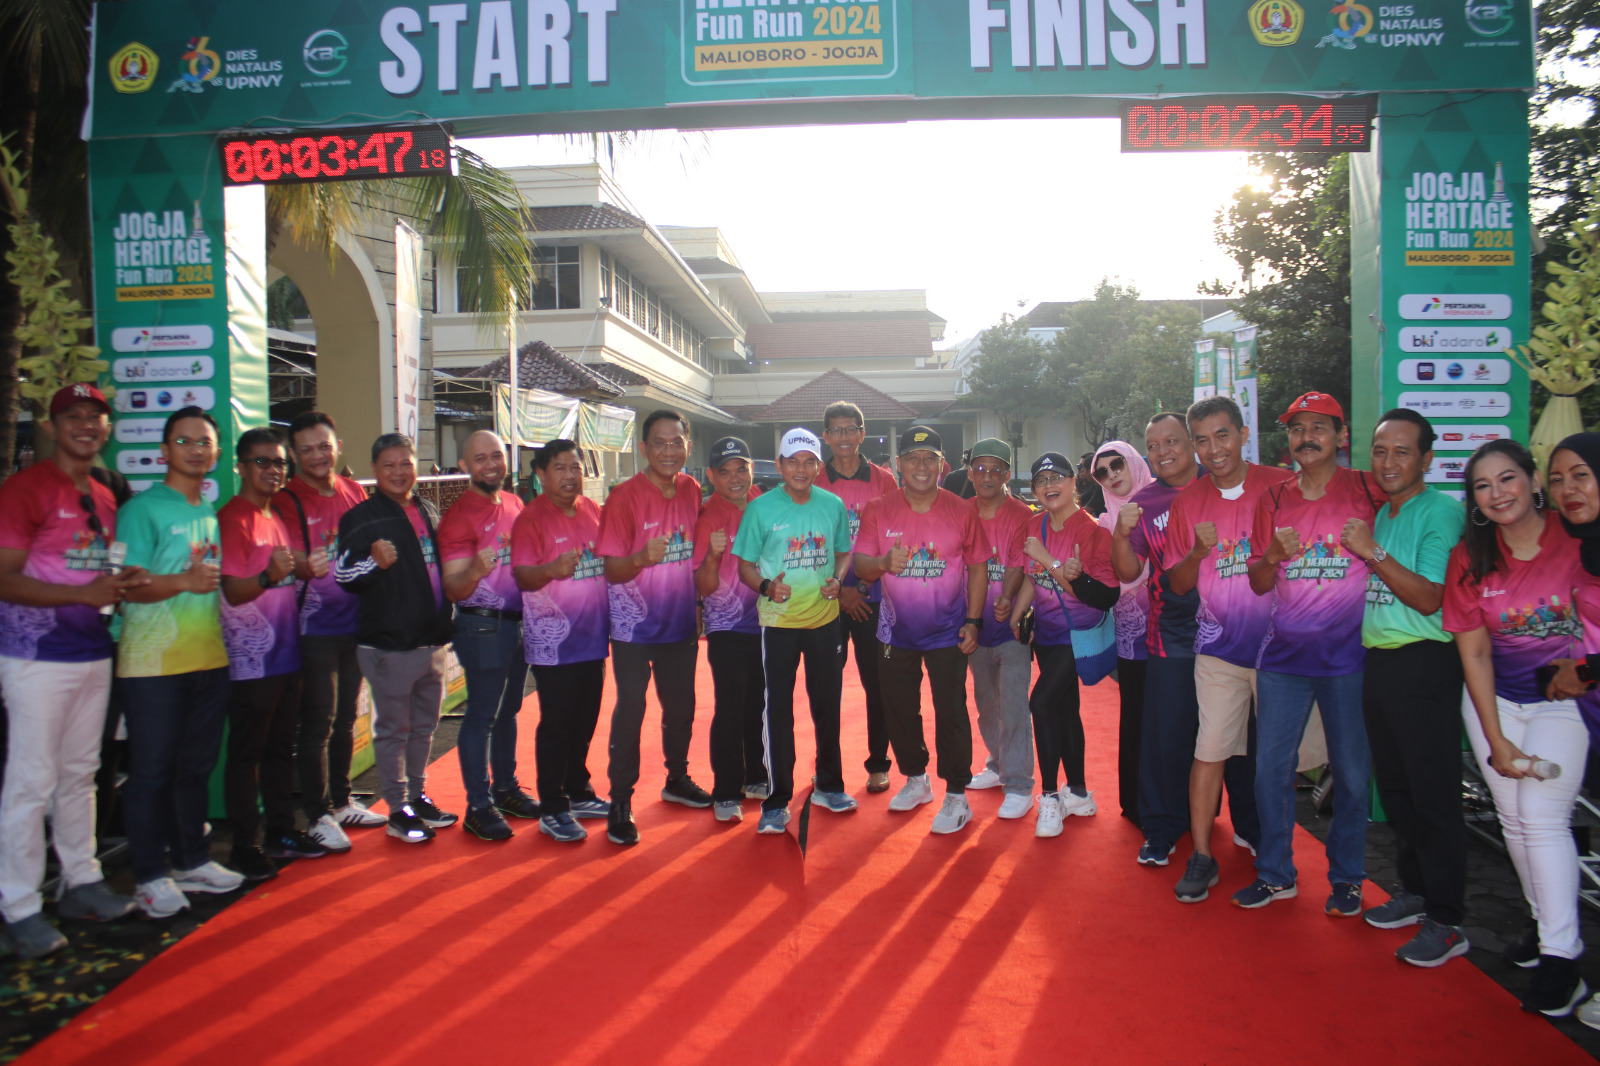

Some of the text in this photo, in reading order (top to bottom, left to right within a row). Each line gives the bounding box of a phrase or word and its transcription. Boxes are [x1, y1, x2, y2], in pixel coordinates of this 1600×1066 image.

[1379, 5, 1415, 17] DIES
[696, 5, 882, 41] Fun Run 2024
[1380, 18, 1443, 31] NATALIS
[969, 0, 1206, 67] FINISH
[1381, 32, 1445, 47] UPNVY
[380, 0, 617, 94] START
[226, 49, 258, 61] DIES
[700, 48, 807, 65] MALIOBORO
[822, 46, 879, 60] JOGJA
[226, 60, 283, 74] NATALIS
[226, 74, 284, 90] UPNVY
[1128, 104, 1365, 147] 00:02:34 95
[224, 131, 446, 182] 00:03:47 18
[1405, 172, 1486, 201] JOGJA
[1406, 202, 1514, 229] HERITAGE
[113, 210, 187, 241] JOGJA
[1406, 230, 1514, 248] Fun Run 2024
[115, 238, 212, 267] HERITAGE
[1408, 254, 1471, 263] MALIOBORO
[1478, 254, 1511, 263] JOGJA
[116, 265, 213, 285] Fun Run 2024
[182, 287, 212, 297] JOGJA
[1440, 337, 1485, 348] adaro
[149, 367, 190, 377] adaro
[788, 437, 816, 447] UPNGC
[1307, 557, 1350, 568] HERITAGE
[910, 568, 926, 577] RUN
[1301, 568, 1320, 578] RUN
[1322, 568, 1345, 578] 2024
